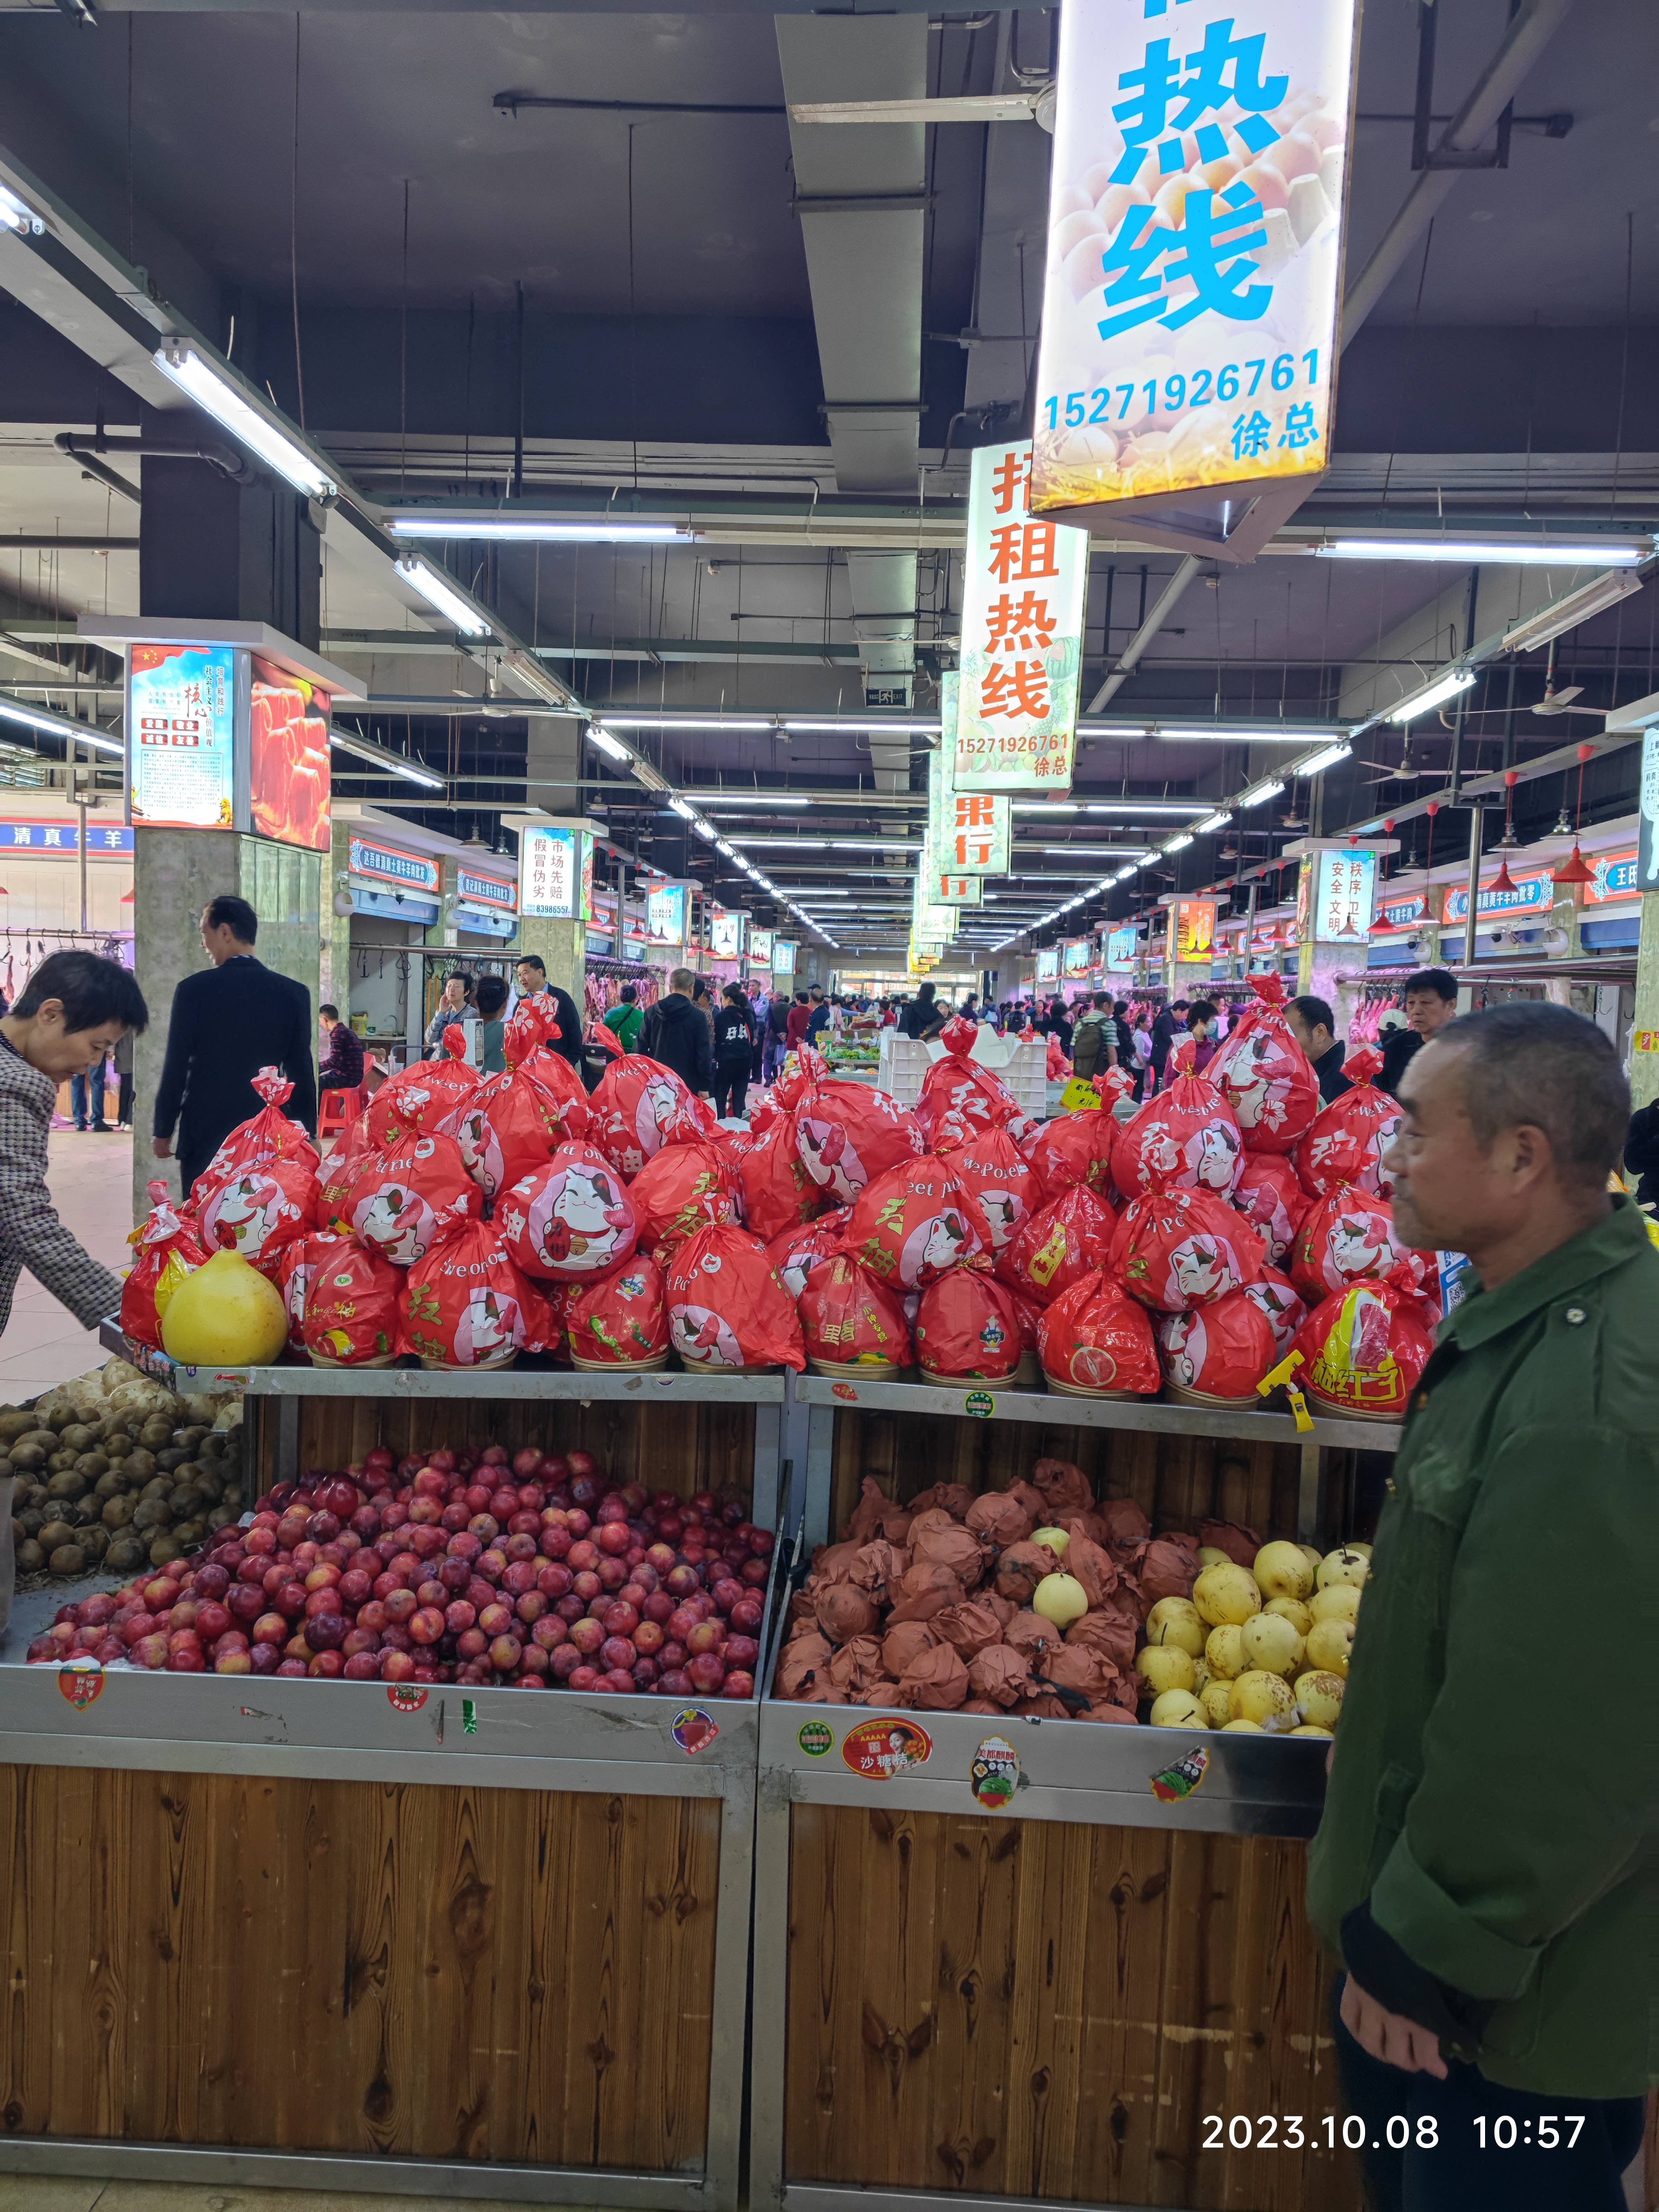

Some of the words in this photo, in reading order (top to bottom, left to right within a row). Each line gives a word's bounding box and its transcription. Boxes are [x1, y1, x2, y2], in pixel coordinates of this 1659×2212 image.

[1098, 0, 1290, 340] 热线
[1045, 348, 1319, 430] 15271926761
[1232, 402, 1319, 460] 徐总
[185, 682, 207, 718] 核心
[146, 719, 163, 729] 爱国
[176, 720, 194, 730] 敬业
[146, 734, 164, 744] 诚信
[176, 735, 194, 746] 友善
[957, 734, 1068, 754] 15271926761
[1034, 756, 1068, 778] 徐总
[955, 795, 995, 864] 果行
[533, 838, 547, 898] 假冒伪劣
[550, 840, 564, 899] 市场先赔
[1331, 861, 1344, 893] 安全
[1349, 861, 1363, 895] 秩序
[536, 905, 568, 914] 83986557
[1328, 900, 1341, 932] 文明
[407, 1281, 448, 1360] 红柚
[861, 1733, 886, 1742] AAAAA
[860, 1752, 908, 1770] 沙糖桔
